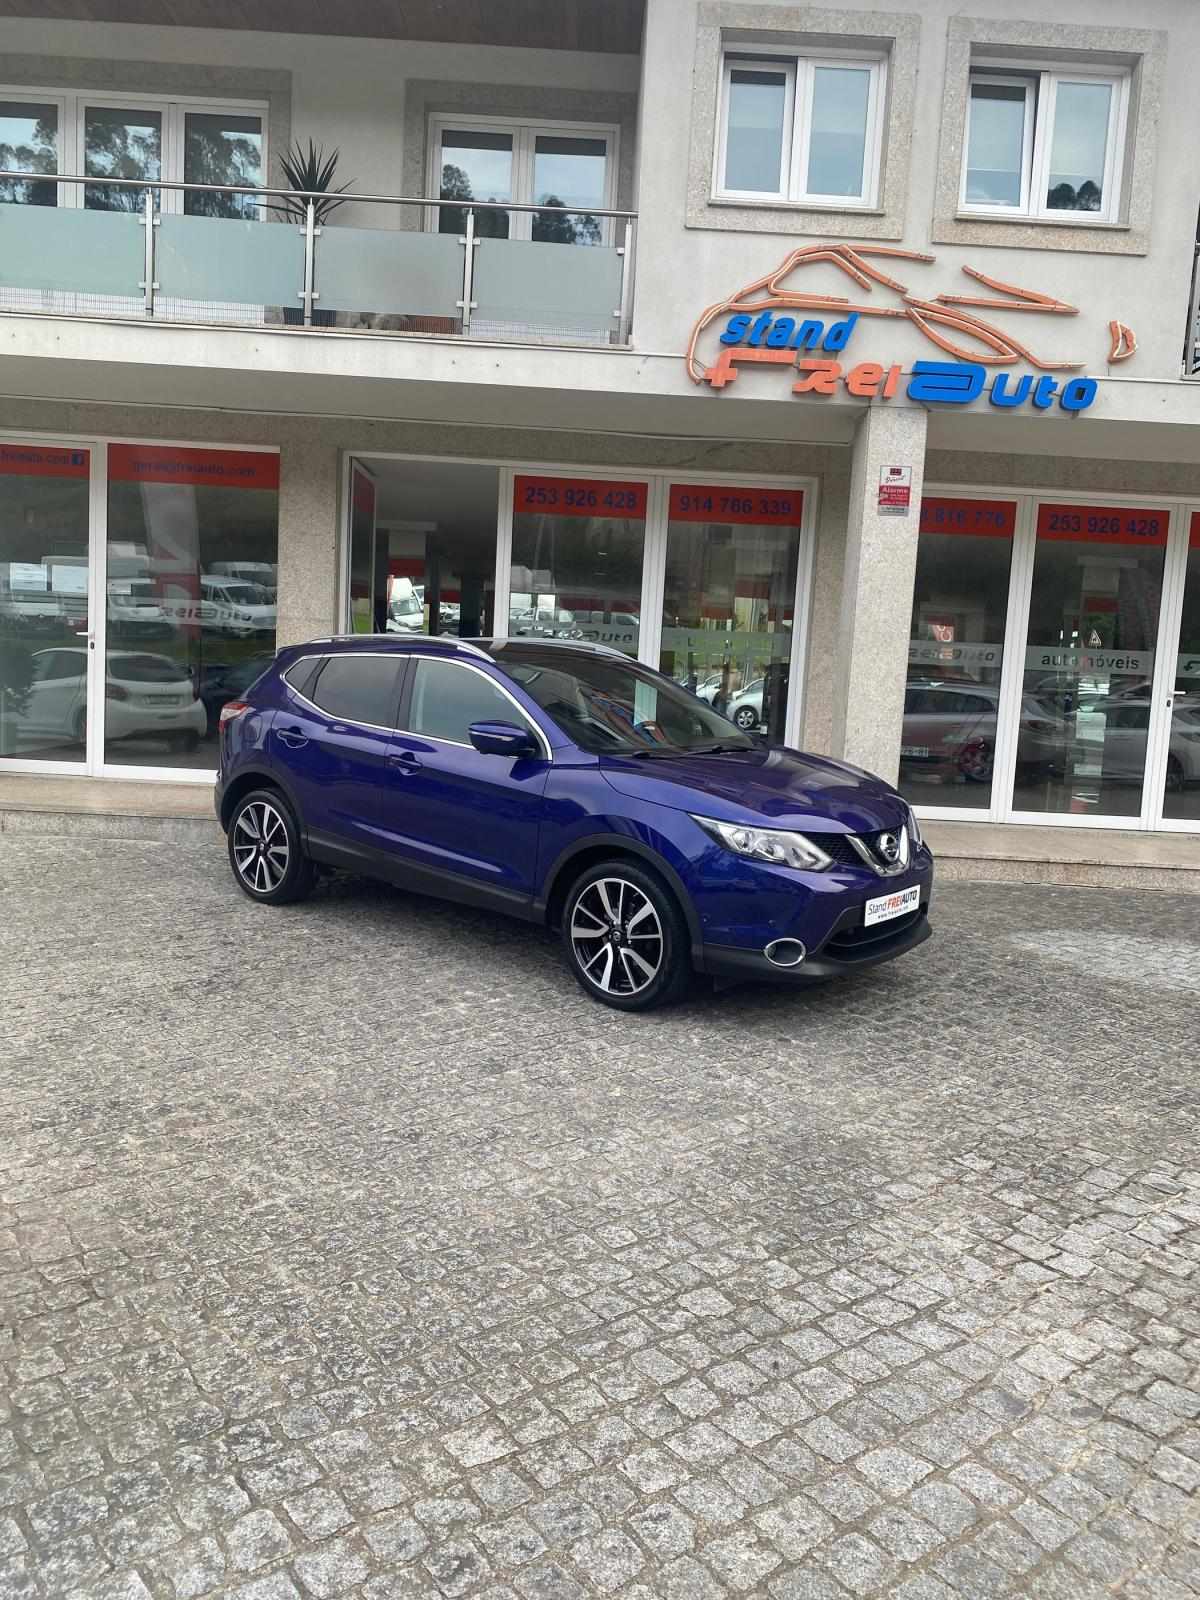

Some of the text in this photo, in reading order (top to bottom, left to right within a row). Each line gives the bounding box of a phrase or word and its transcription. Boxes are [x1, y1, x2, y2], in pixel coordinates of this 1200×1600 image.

[524, 486, 637, 510] 253 926 428
[680, 495, 713, 513] 914
[1049, 514, 1159, 537] 253 926 428
